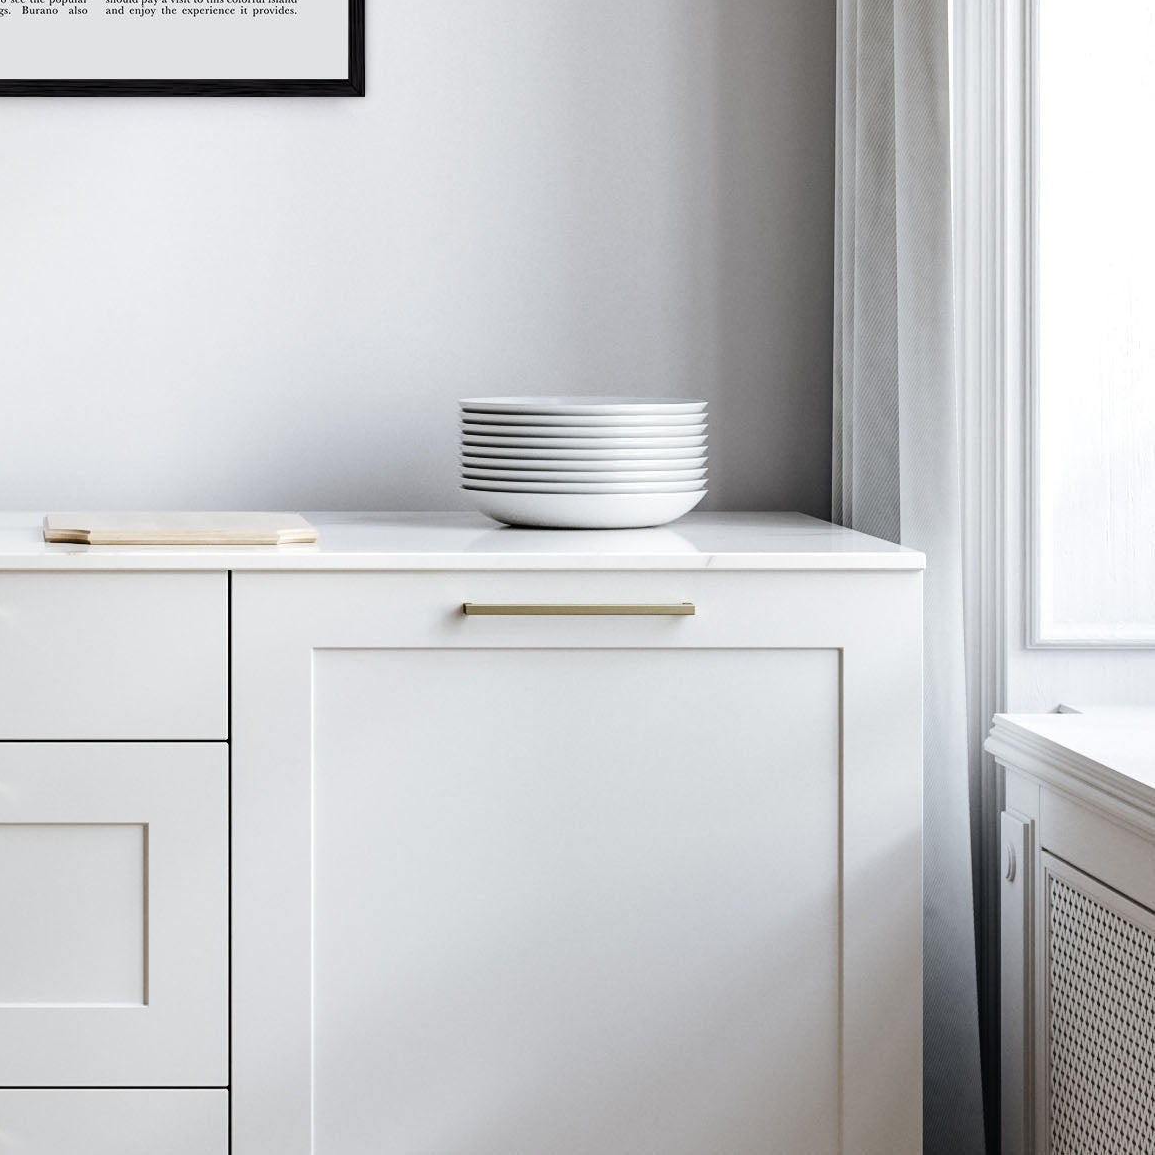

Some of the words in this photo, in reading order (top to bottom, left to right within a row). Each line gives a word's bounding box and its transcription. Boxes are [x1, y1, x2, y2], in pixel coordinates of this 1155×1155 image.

[22, 6, 59, 15] Burano
[68, 6, 88, 15] also
[105, 6, 125, 15] and
[129, 6, 157, 17] enjoy
[161, 6, 177, 15] the
[181, 6, 236, 17] experience
[240, 6, 248, 15] it
[253, 6, 297, 17] provides.
